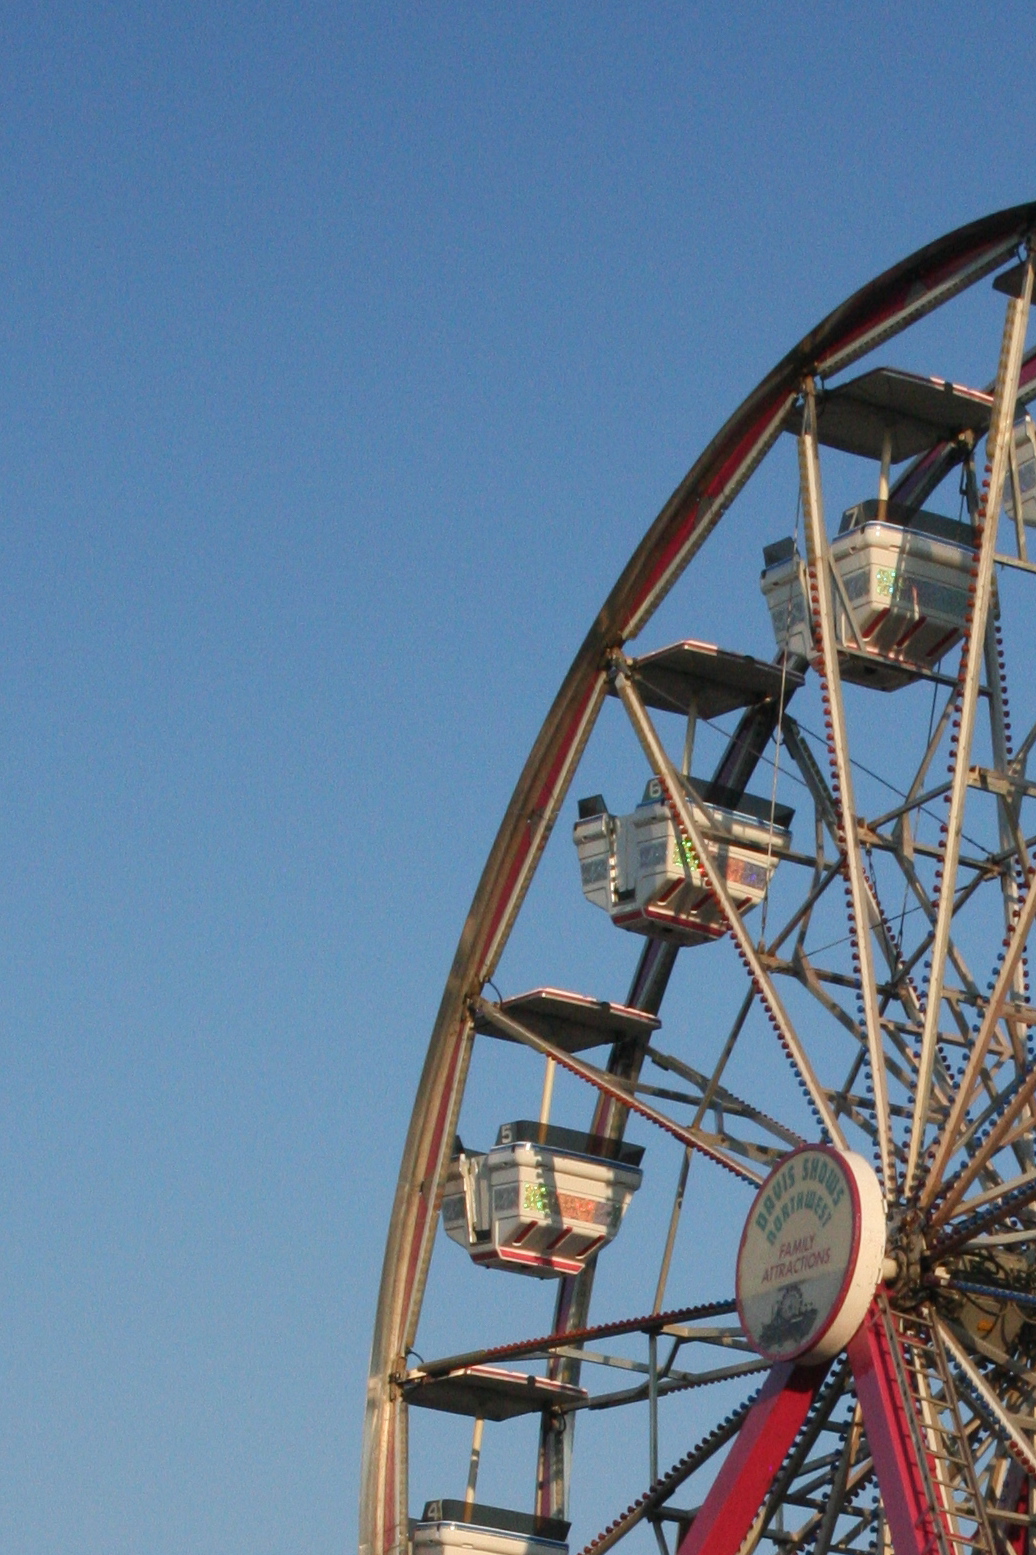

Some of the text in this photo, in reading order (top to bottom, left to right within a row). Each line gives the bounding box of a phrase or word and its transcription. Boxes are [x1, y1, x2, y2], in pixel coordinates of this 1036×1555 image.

[846, 507, 859, 529] 7
[649, 780, 662, 799] 6
[501, 1125, 512, 1144] 5
[755, 1158, 845, 1232] DAVIS SHOWS
[779, 1233, 816, 1259] FAMILY
[761, 1247, 831, 1284] ATTRACTIONS
[428, 1502, 438, 1521] 4
